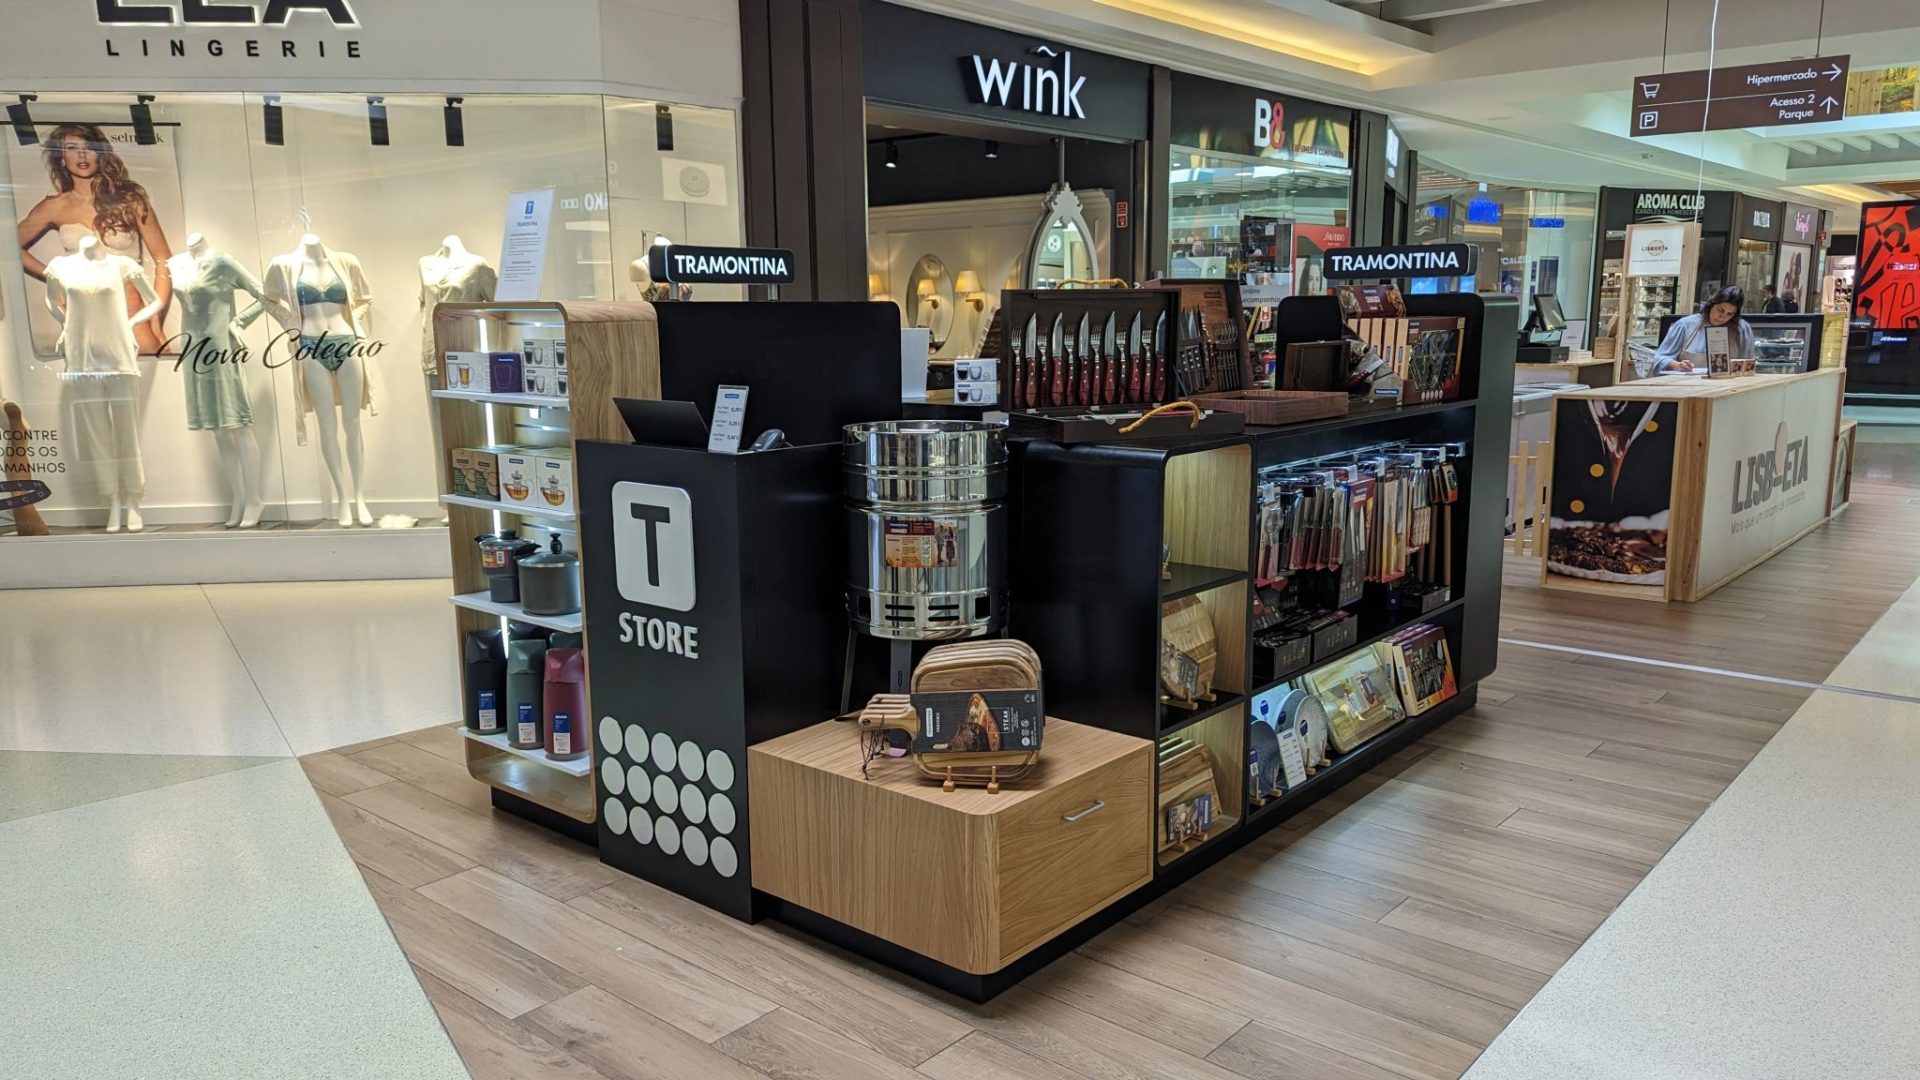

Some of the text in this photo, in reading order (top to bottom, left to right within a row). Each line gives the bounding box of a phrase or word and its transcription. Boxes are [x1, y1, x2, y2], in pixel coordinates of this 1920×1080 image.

[106, 39, 361, 58] LINGERIE
[1747, 68, 1817, 85] Hipermercado
[1770, 94, 1815, 108] Acesso 2
[1779, 110, 1813, 120] Parque
[1637, 193, 1706, 209] AROMA CLUB
[674, 254, 788, 276] TRAMONTINA
[1331, 251, 1459, 272] TRAMONTINA
[156, 328, 389, 375] Nova Coleção
[0, 430, 58, 441] CONTRE
[39, 446, 58, 457] OS
[630, 502, 671, 588] T
[618, 611, 699, 660] STORE
